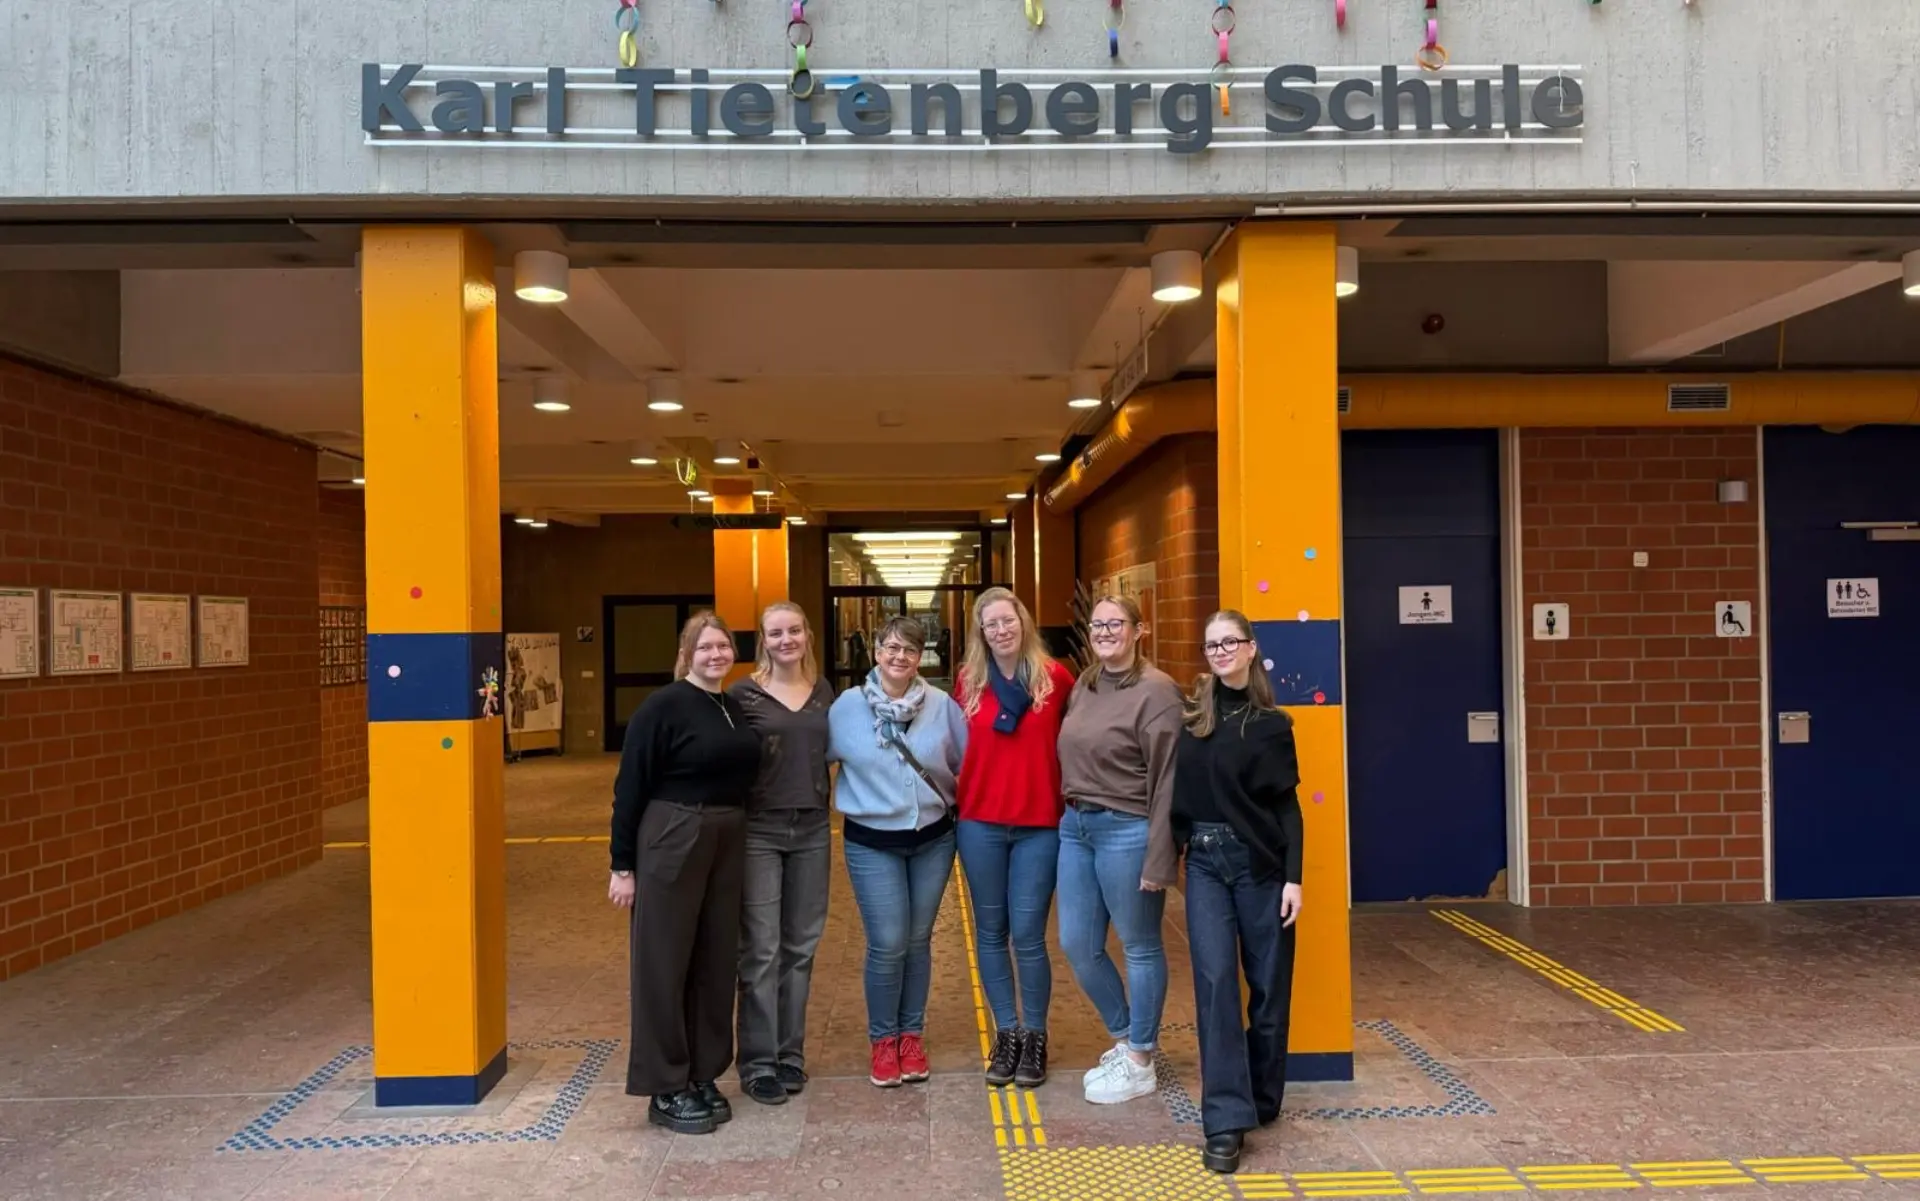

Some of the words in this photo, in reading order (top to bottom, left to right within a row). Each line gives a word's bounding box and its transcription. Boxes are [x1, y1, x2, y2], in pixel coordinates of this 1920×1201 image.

[361, 63, 566, 135] Karl
[615, 68, 1213, 153] Tietenberg
[1263, 63, 1584, 134] Schule
